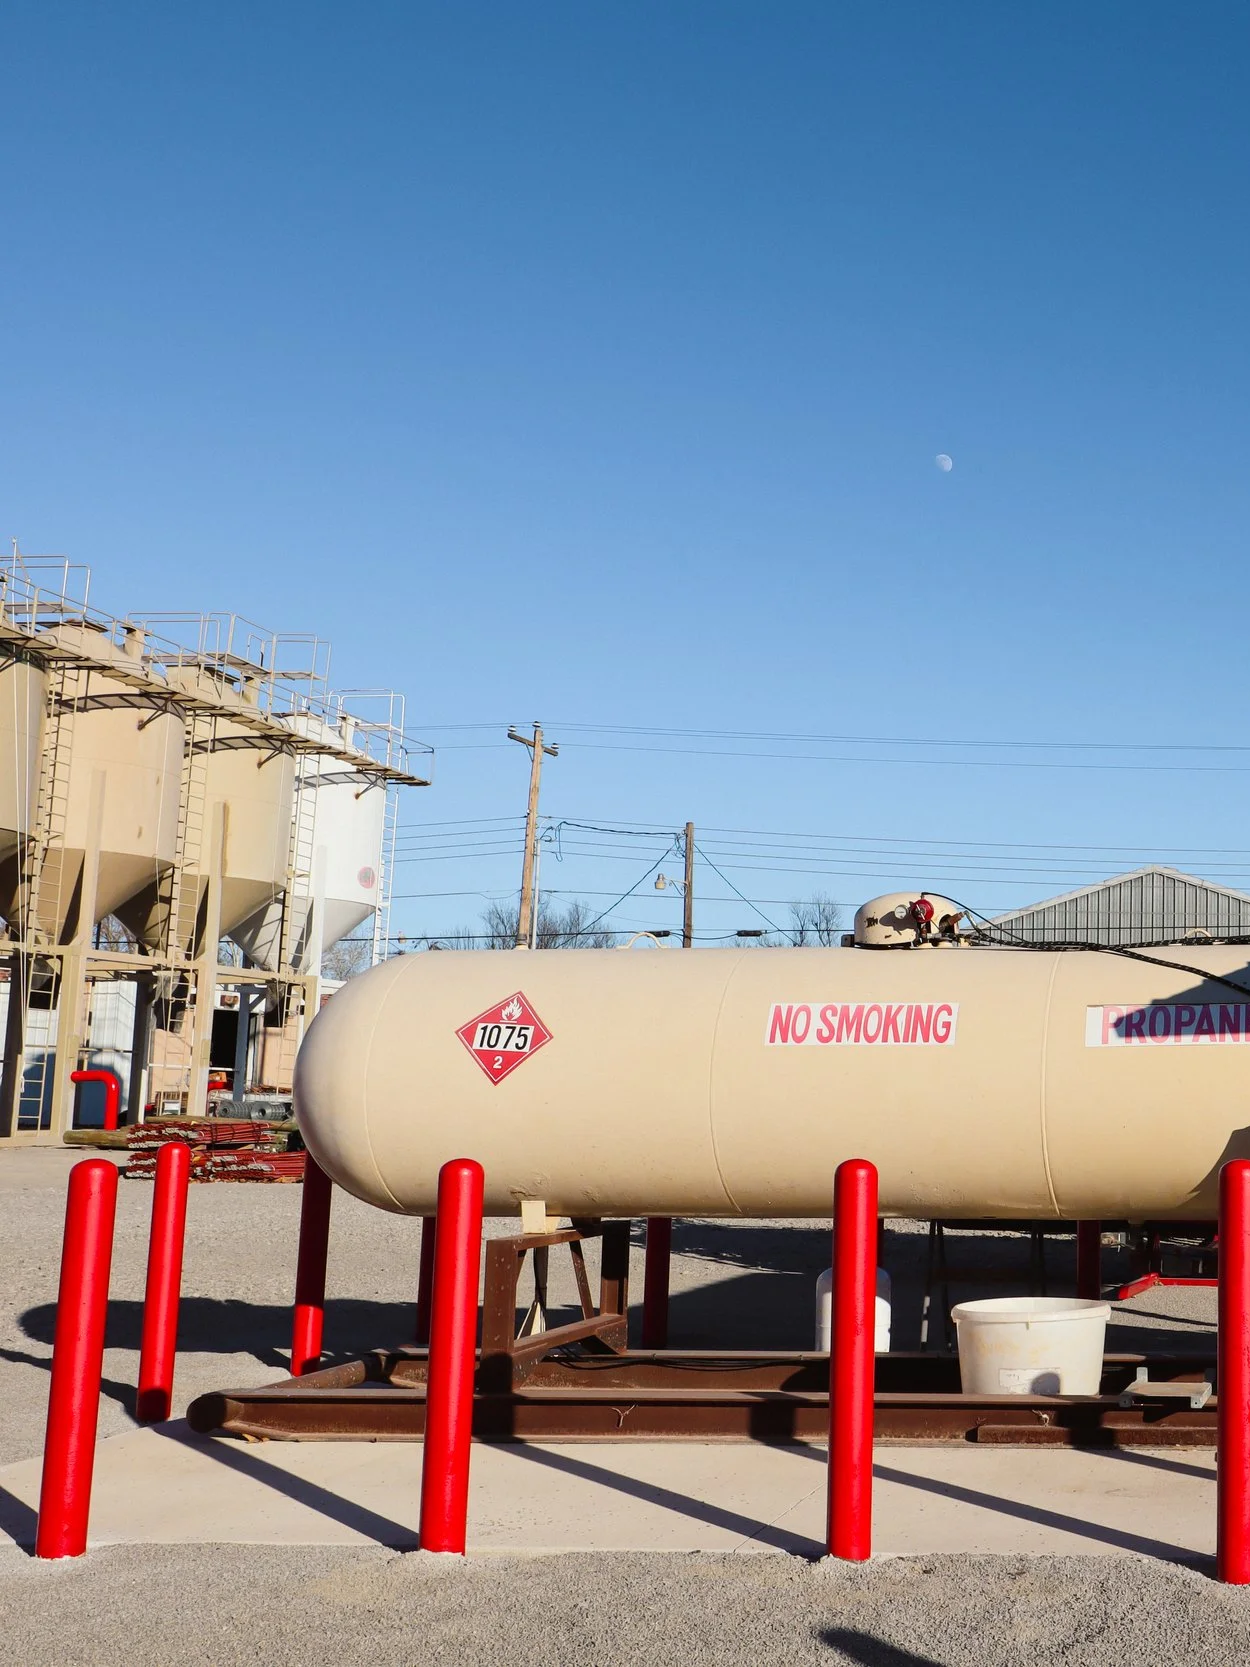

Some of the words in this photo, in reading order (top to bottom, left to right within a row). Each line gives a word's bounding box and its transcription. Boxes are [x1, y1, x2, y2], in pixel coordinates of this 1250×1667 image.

[479, 1024, 530, 1050] 1075
[769, 1004, 812, 1044] NO
[816, 1004, 953, 1044] SMOKING
[492, 1055, 503, 1069] 2
